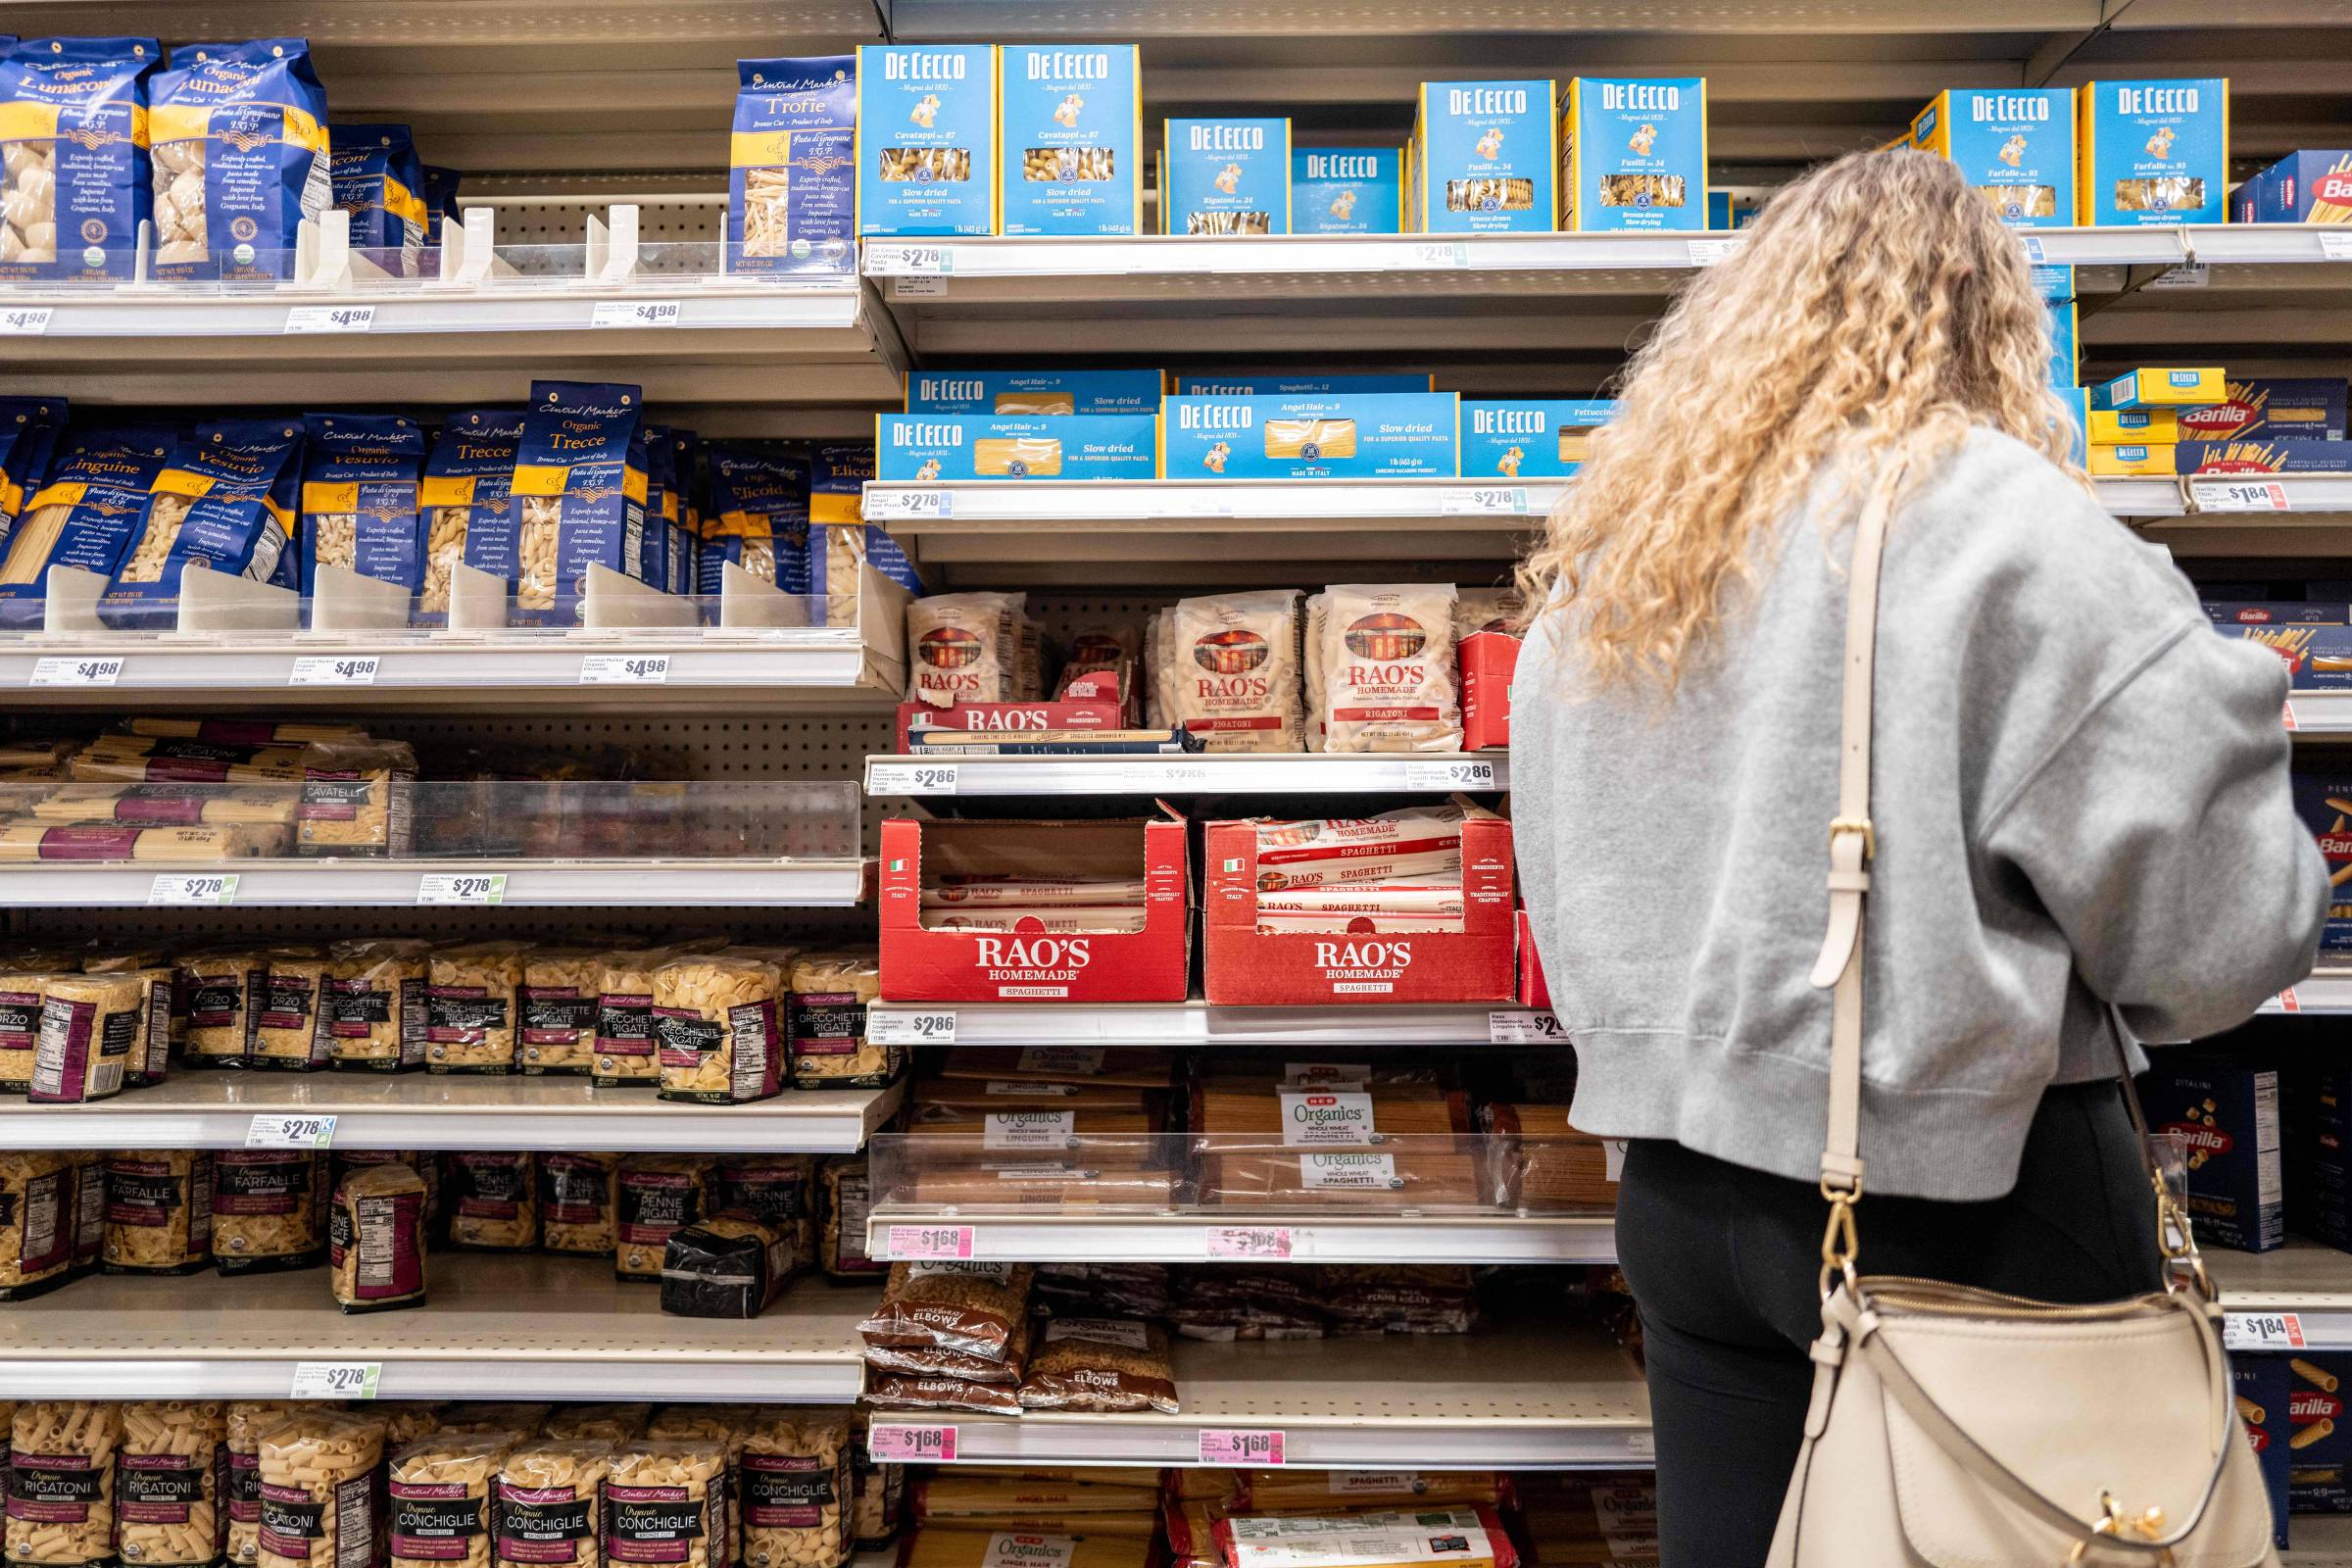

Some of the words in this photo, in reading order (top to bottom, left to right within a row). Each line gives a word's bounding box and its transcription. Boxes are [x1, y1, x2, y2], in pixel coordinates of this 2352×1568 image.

[885, 52, 908, 80] DE
[911, 52, 966, 80] CECCO
[1028, 52, 1051, 80] DE
[1054, 52, 1108, 79] CECCO
[204, 67, 247, 80] Organic
[1449, 89, 1471, 116] DE
[1474, 88, 1527, 115] CECCO
[1602, 83, 1625, 111] DE
[1628, 83, 1680, 111] CECCO
[2119, 88, 2141, 115] DE
[2144, 88, 2199, 114] CECCO
[765, 98, 826, 115] Trofie
[1973, 96, 1994, 122] DE
[1997, 96, 2049, 122] CECCO
[1191, 125, 1211, 150] DE
[1214, 125, 1263, 150] CECCO
[1307, 155, 1327, 178] DE
[1330, 155, 1377, 178] CECCO
[902, 188, 922, 197] Slow
[924, 188, 948, 197] dried
[1046, 188, 1066, 197] Slow
[1068, 188, 1092, 197] dried
[941, 379, 984, 401] CECCO
[1116, 396, 1142, 405] dried
[539, 403, 580, 415] Central
[583, 406, 633, 416] Market
[1180, 405, 1200, 428] DE
[1203, 405, 1253, 428] CECCO
[1474, 410, 1494, 434] DE
[1496, 410, 1545, 433] CECCO
[562, 419, 603, 432] Organic
[1379, 423, 1401, 433] Slow
[1402, 423, 1433, 433] dried
[323, 431, 366, 440] Central
[367, 431, 415, 441] Market
[550, 432, 607, 450] Trecce
[894, 422, 913, 447] DE
[915, 422, 963, 447] CECCO
[457, 445, 513, 460] Trecce
[1083, 444, 1106, 453] Slow
[1107, 444, 1134, 453] dried
[200, 451, 265, 474] Vesuvio
[576, 547, 599, 556] Imported
[2239, 612, 2269, 621] Barilla
[1348, 665, 1424, 686] RAO'S
[919, 674, 980, 691] RAO'S
[1197, 678, 1267, 698] RAO'S
[1204, 698, 1260, 707] HOMEMADE
[965, 710, 1049, 730] RAO'S
[1365, 709, 1408, 718] RIGATONI
[307, 787, 362, 798] CAVATELLI
[1337, 824, 1396, 838] HOMEMADE
[1341, 845, 1397, 858] SPAGHETTI
[1291, 871, 1324, 886] RAO'S
[1340, 864, 1394, 879] SPAGHETTI
[971, 887, 1004, 897] RAO'S
[1020, 887, 1074, 896] SPAGHETTI
[1267, 902, 1302, 911] RAO'S
[1321, 903, 1381, 912] SPAGHETTI
[975, 938, 1090, 968] RAO'S
[1314, 942, 1411, 968] RAO'S
[989, 968, 1077, 981] HOMEMADE
[1326, 969, 1401, 980] HOMEMADE
[1005, 988, 1061, 997] SPAGHETTI
[199, 996, 230, 1006] ORZO
[271, 996, 301, 1006] ORZO
[526, 1004, 590, 1014] ORECCHIETTE
[799, 1013, 866, 1023] ORECCHIETTE
[612, 1024, 650, 1033] RIGATE
[659, 1025, 717, 1037] ORECCHIETTE
[668, 1034, 704, 1047] RIGATE
[2176, 1078, 2212, 1090] DITALINI
[1295, 1104, 1363, 1126] Organics
[234, 1175, 301, 1189] FARFALLE
[112, 1184, 171, 1200] FARFALLE
[641, 1196, 684, 1208] PENNE
[638, 1207, 684, 1220] RIGATE
[913, 1313, 959, 1325] ELBOWS
[1074, 1374, 1119, 1386] ELBOWS
[917, 1381, 964, 1393] ELBOWS
[2289, 1398, 2335, 1415] arilla
[24, 1481, 91, 1494] RIGATONI
[128, 1482, 191, 1494] RIGATONI
[752, 1483, 827, 1497] CONCHIGLIE
[399, 1513, 475, 1527] CONCHIGLIE
[507, 1515, 584, 1530] CONCHIGLIE
[617, 1516, 697, 1529] CONCHIGLIE
[999, 1539, 1062, 1557] Organics
